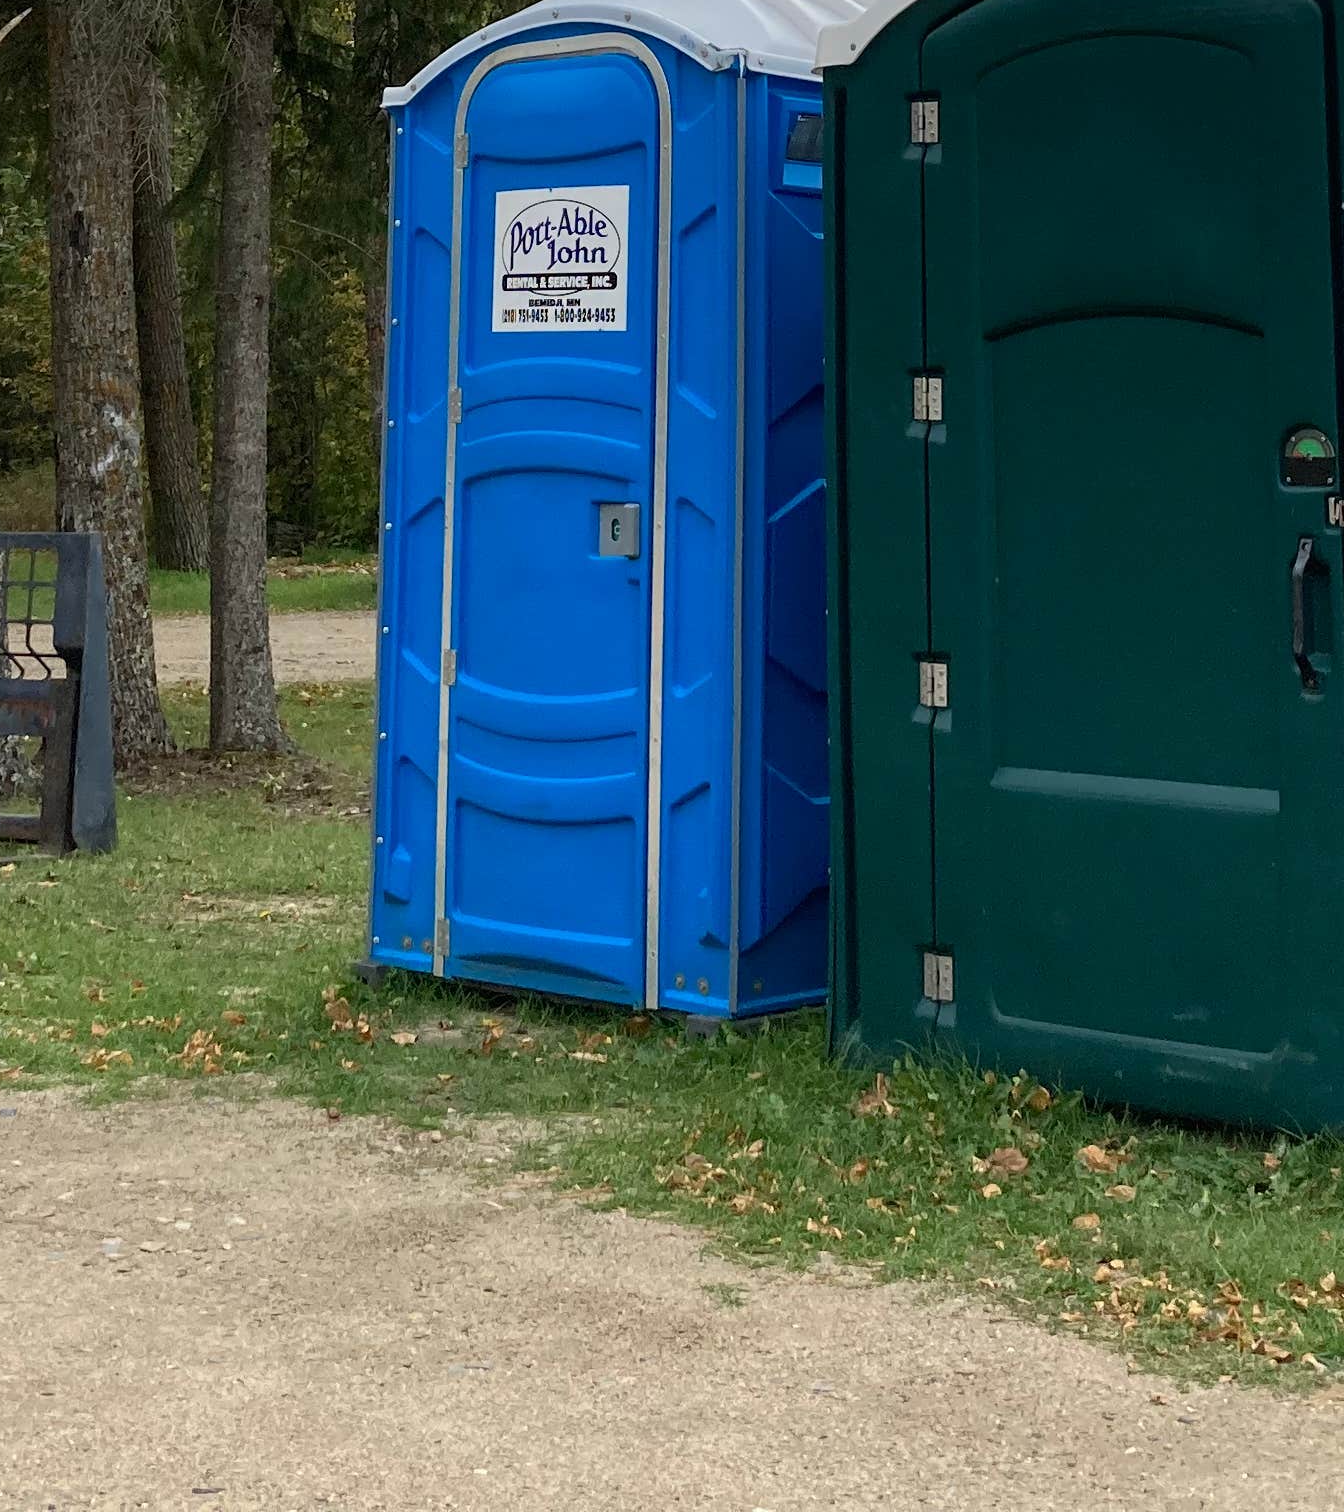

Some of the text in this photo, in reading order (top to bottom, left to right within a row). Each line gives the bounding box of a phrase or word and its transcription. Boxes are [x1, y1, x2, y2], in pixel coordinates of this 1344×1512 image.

[510, 207, 608, 271] Port-Able
[547, 237, 608, 270] John
[506, 274, 613, 289] RENTAL & SERVICE, INC.
[554, 307, 616, 323] 1-800-924-9453
